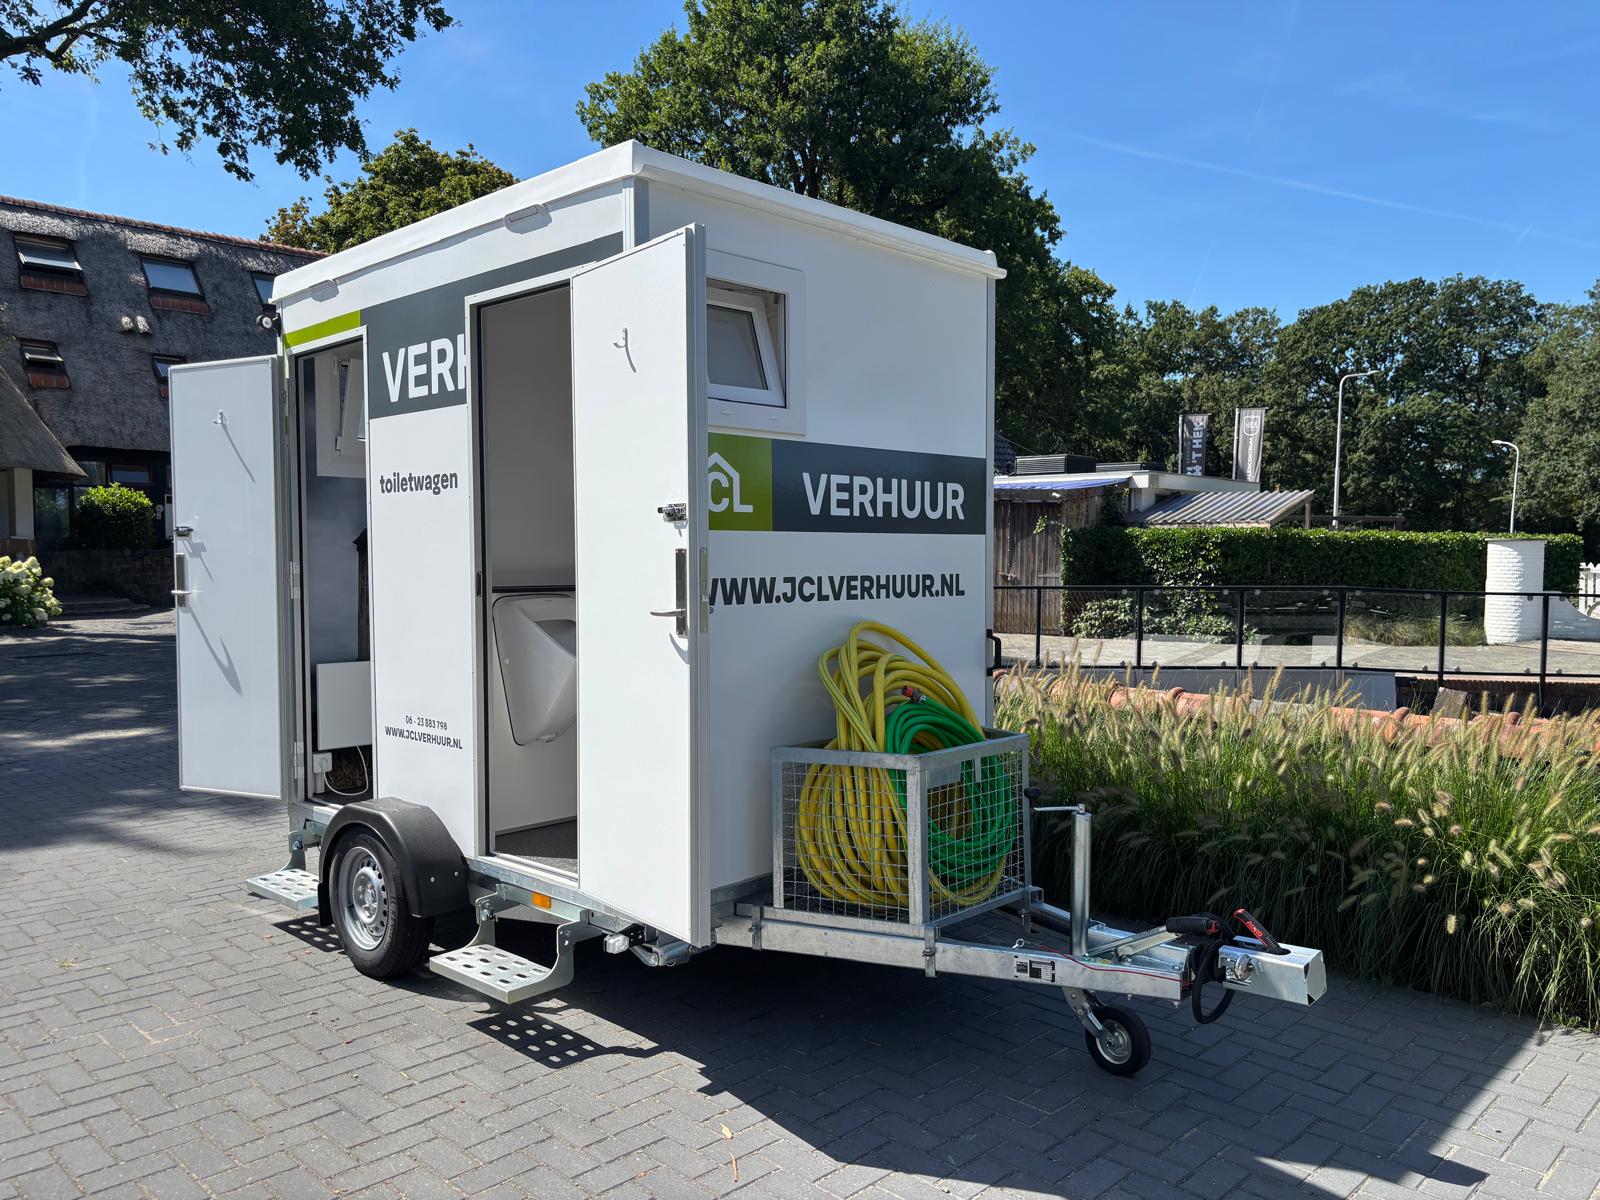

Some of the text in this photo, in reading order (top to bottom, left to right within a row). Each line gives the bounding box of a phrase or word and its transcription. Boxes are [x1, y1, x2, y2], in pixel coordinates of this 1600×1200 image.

[1192, 421, 1204, 449] HEK
[379, 471, 458, 495] toiletwagen
[802, 472, 965, 520] VERHUUR
[405, 715, 413, 725] 06
[417, 716, 424, 727] 23
[425, 718, 436, 729] 883
[436, 720, 448, 731] 798
[384, 725, 463, 750] WWW.JCLVERHUUR.NL
